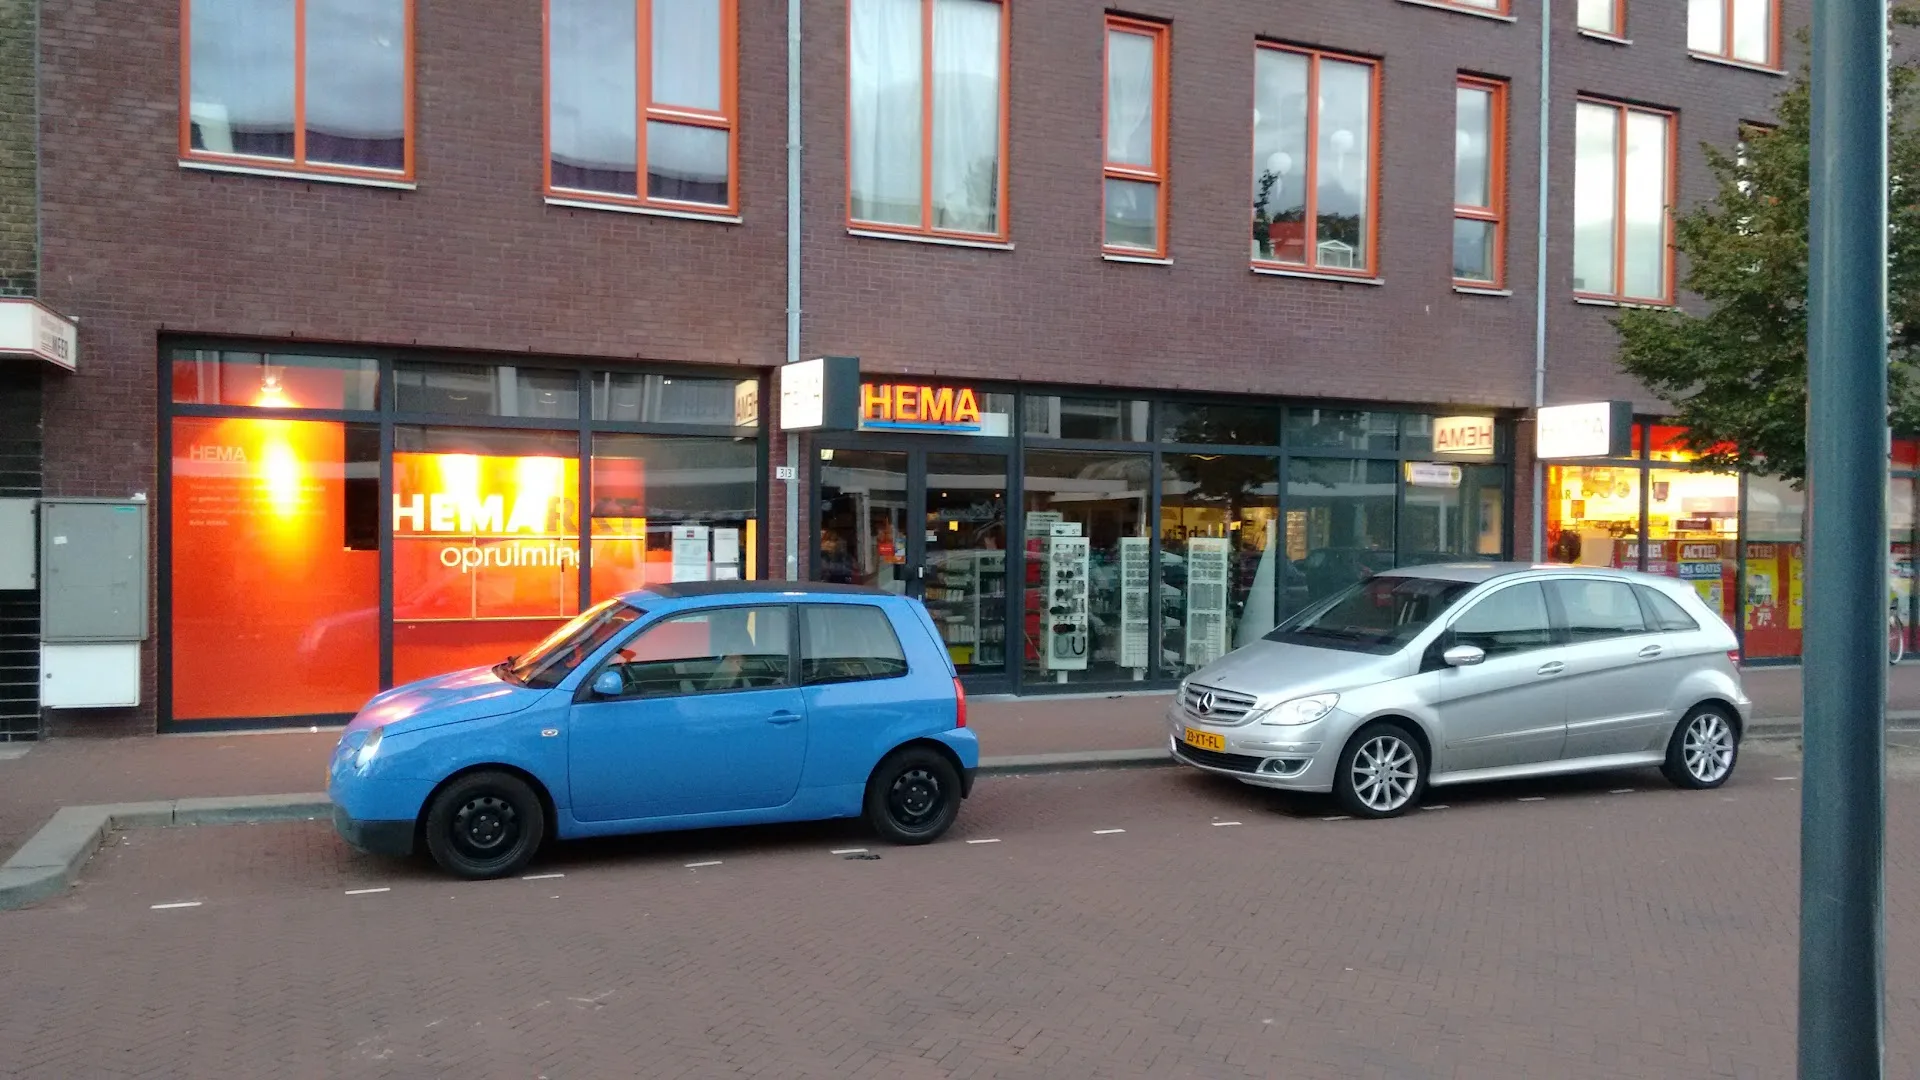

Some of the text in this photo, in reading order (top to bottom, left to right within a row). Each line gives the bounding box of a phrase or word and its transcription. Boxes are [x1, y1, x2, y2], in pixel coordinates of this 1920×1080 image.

[861, 383, 981, 422] HEMA
[189, 445, 247, 461] HEMA
[780, 468, 792, 478] 313
[1683, 544, 1717, 559] ACTIE!
[1745, 545, 1774, 559] CTIE!
[1695, 563, 1721, 574] GRATIS
[1186, 729, 1220, 749] 23-XT-FL
